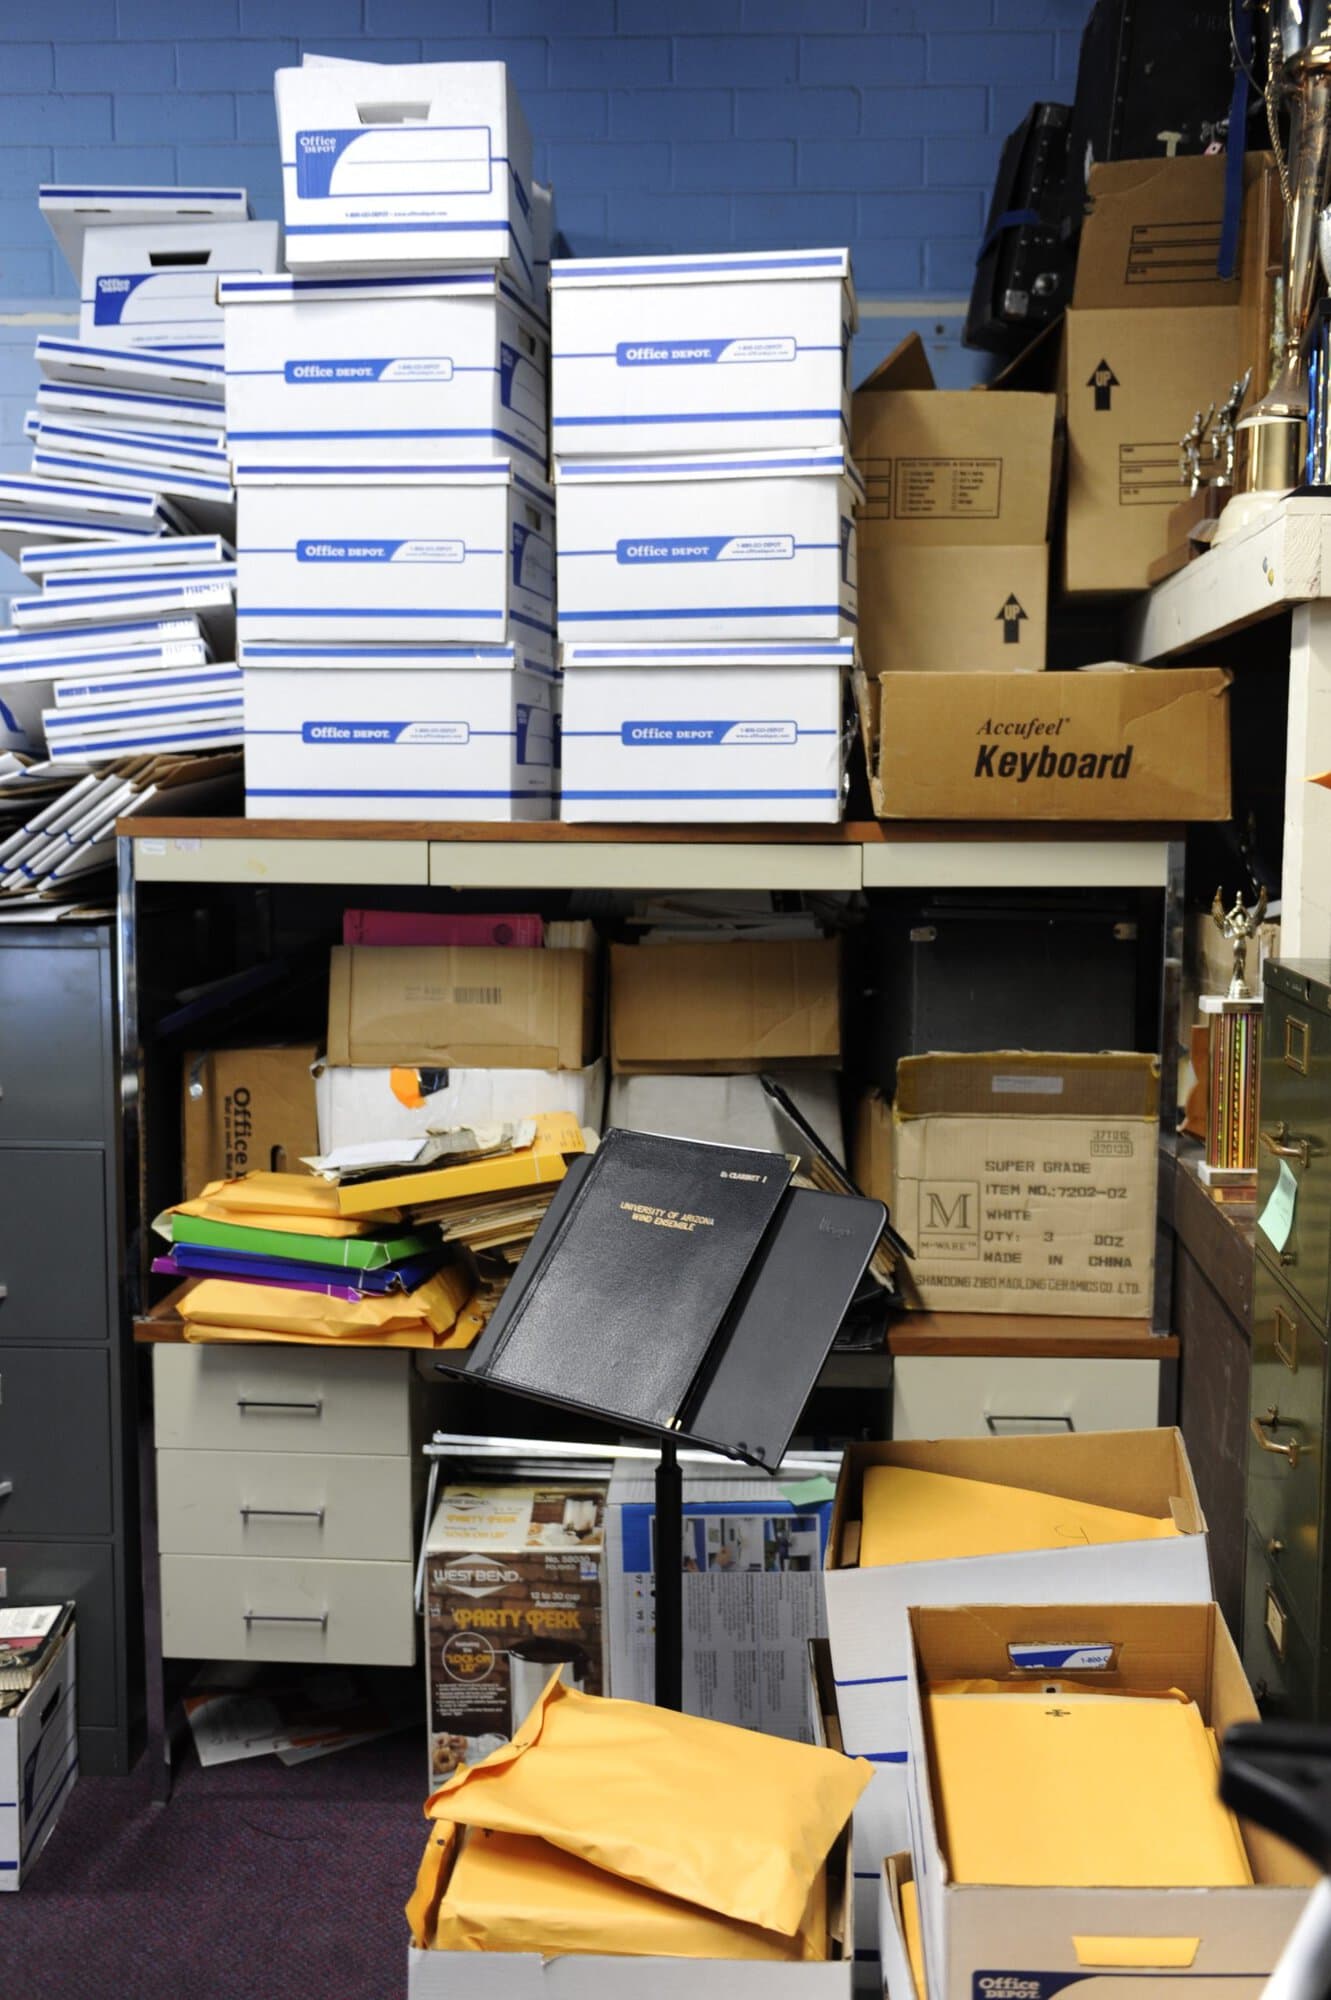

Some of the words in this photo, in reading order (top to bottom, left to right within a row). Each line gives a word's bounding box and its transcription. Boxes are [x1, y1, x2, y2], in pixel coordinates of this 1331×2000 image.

[300, 136, 336, 146] Office
[626, 348, 669, 360] Office
[293, 365, 334, 377] Office
[1096, 371, 1111, 386] UP
[305, 545, 345, 557] Office
[627, 545, 668, 557] Office
[1004, 604, 1020, 620] UP
[311, 727, 350, 739] Office
[632, 728, 673, 740] Office
[974, 745, 1134, 783] Keyboard
[234, 1087, 252, 1164] Office
[985, 1160, 1035, 1172] SUPER
[1043, 1162, 1091, 1173] GRADE
[985, 1184, 1020, 1195] ITEM
[620, 1201, 666, 1217] UNIVERSITY
[667, 1211, 680, 1219] OF
[680, 1213, 715, 1226] ARIZONA
[926, 1193, 972, 1229] M
[986, 1209, 1032, 1221] WHITE
[631, 1212, 653, 1223] WIND
[653, 1217, 696, 1231] ENSEMBLE
[983, 1231, 1020, 1242] QTY:
[1043, 1232, 1054, 1242] 3
[1094, 1235, 1124, 1247] DOZ
[984, 1252, 1022, 1263] MADE
[1048, 1255, 1063, 1265] IN
[1088, 1256, 1133, 1268] CHINA
[915, 1275, 971, 1288] SHANDONG
[545, 1555, 559, 1564] No.
[433, 1569, 473, 1584] WEST
[475, 1570, 519, 1583] BEND
[453, 1608, 520, 1630] PARTY
[525, 1609, 580, 1632] PERK
[978, 1977, 1040, 1989] Office
